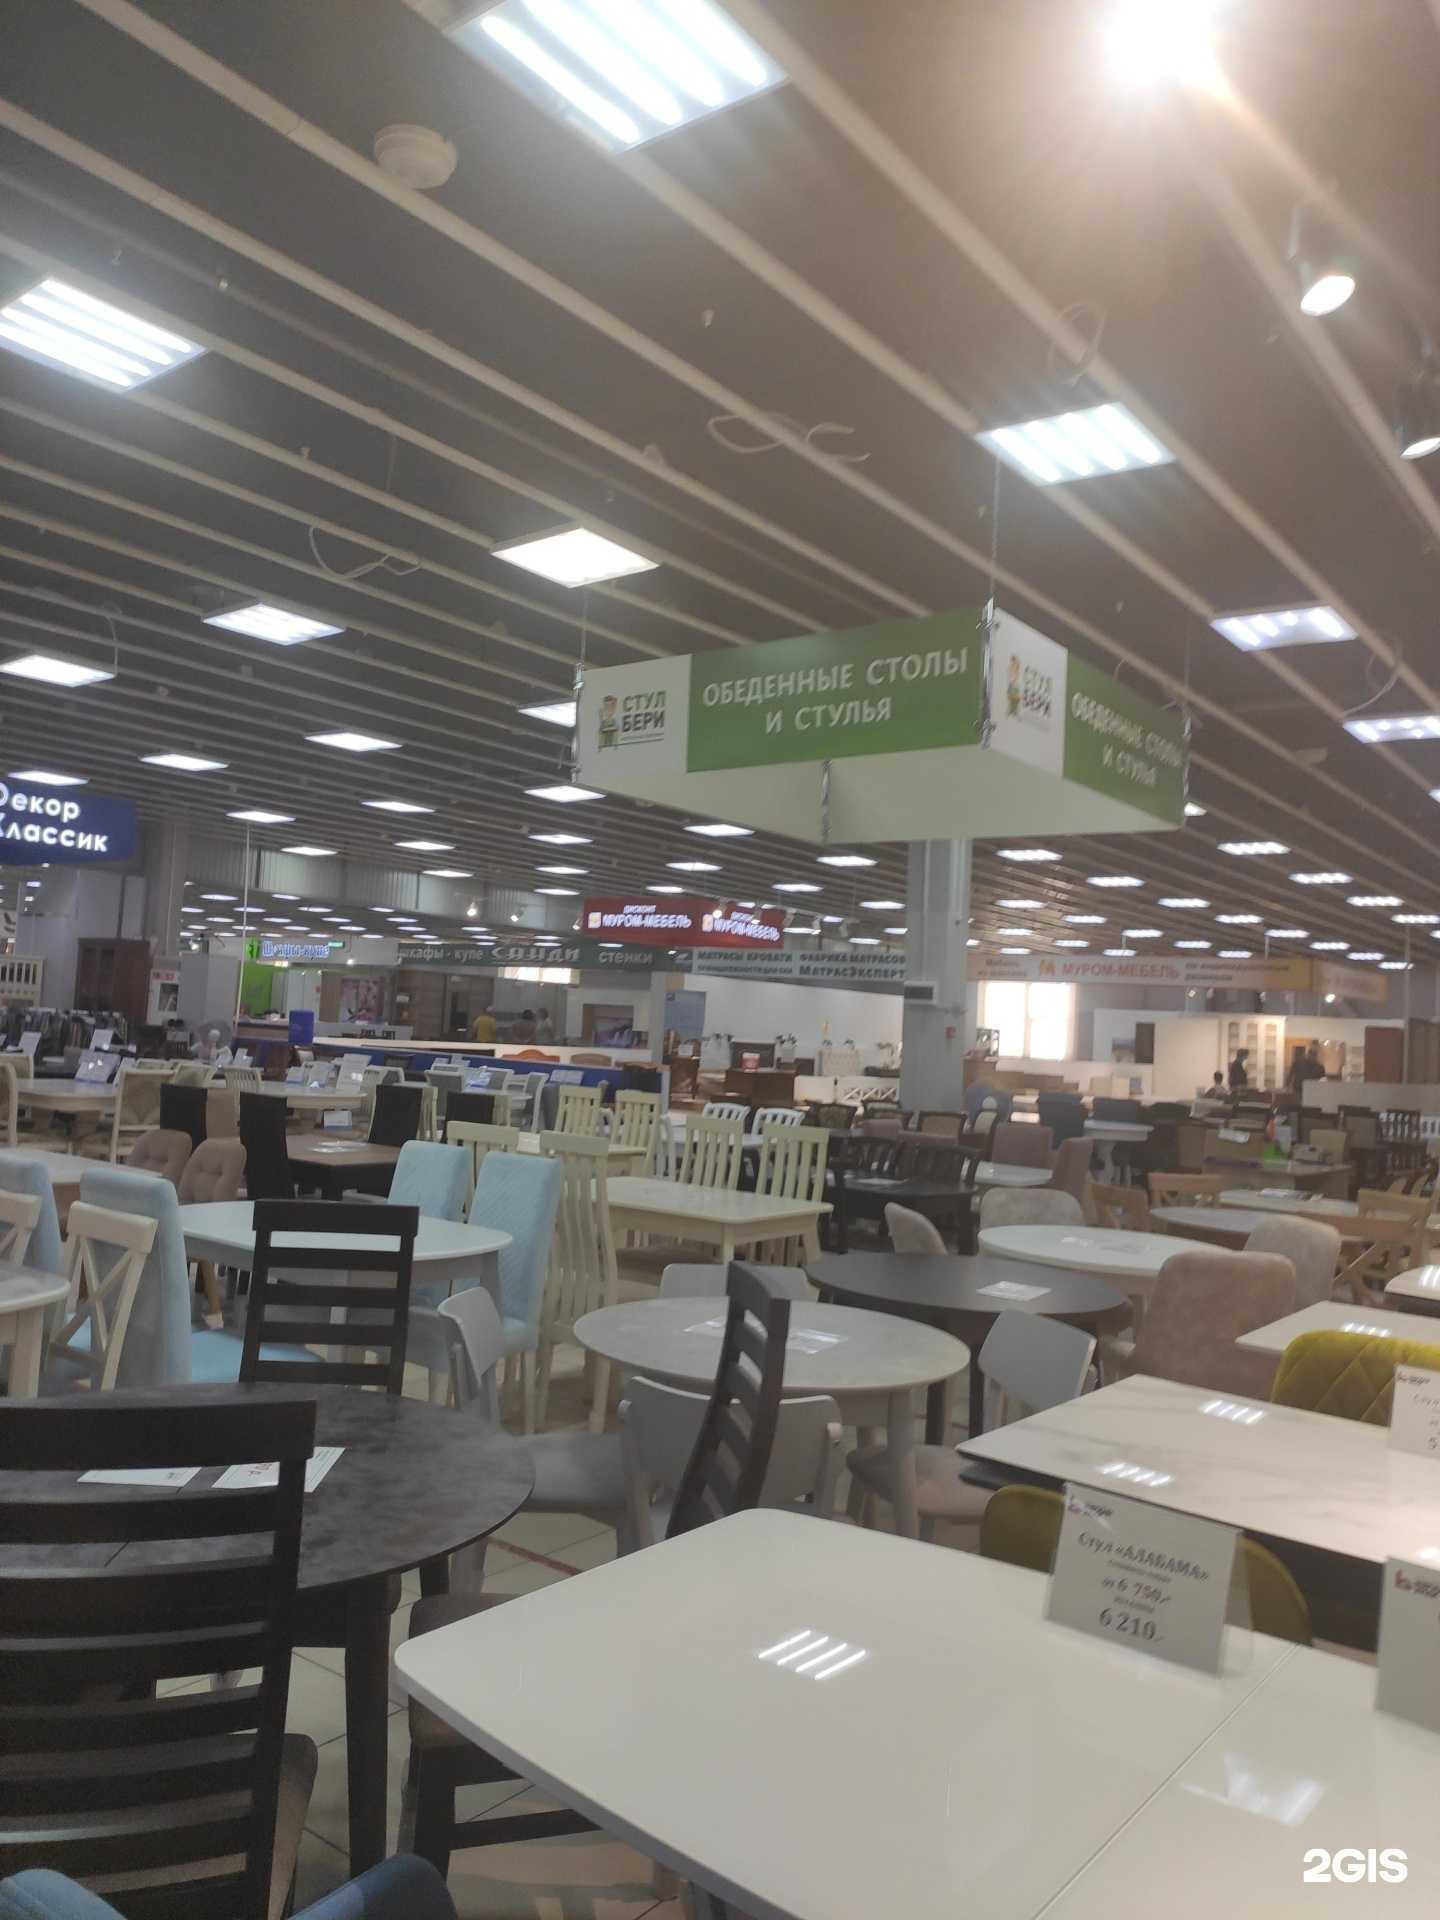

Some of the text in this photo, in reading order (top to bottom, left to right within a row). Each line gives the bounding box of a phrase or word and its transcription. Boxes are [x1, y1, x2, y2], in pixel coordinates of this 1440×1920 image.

[702, 647, 968, 707] ОБЕДЕННЫЕ СТОЛЫ
[623, 691, 666, 712] СТУЛ
[765, 697, 892, 735] И СТУЛЬЯ
[622, 710, 665, 732] БЕРИ
